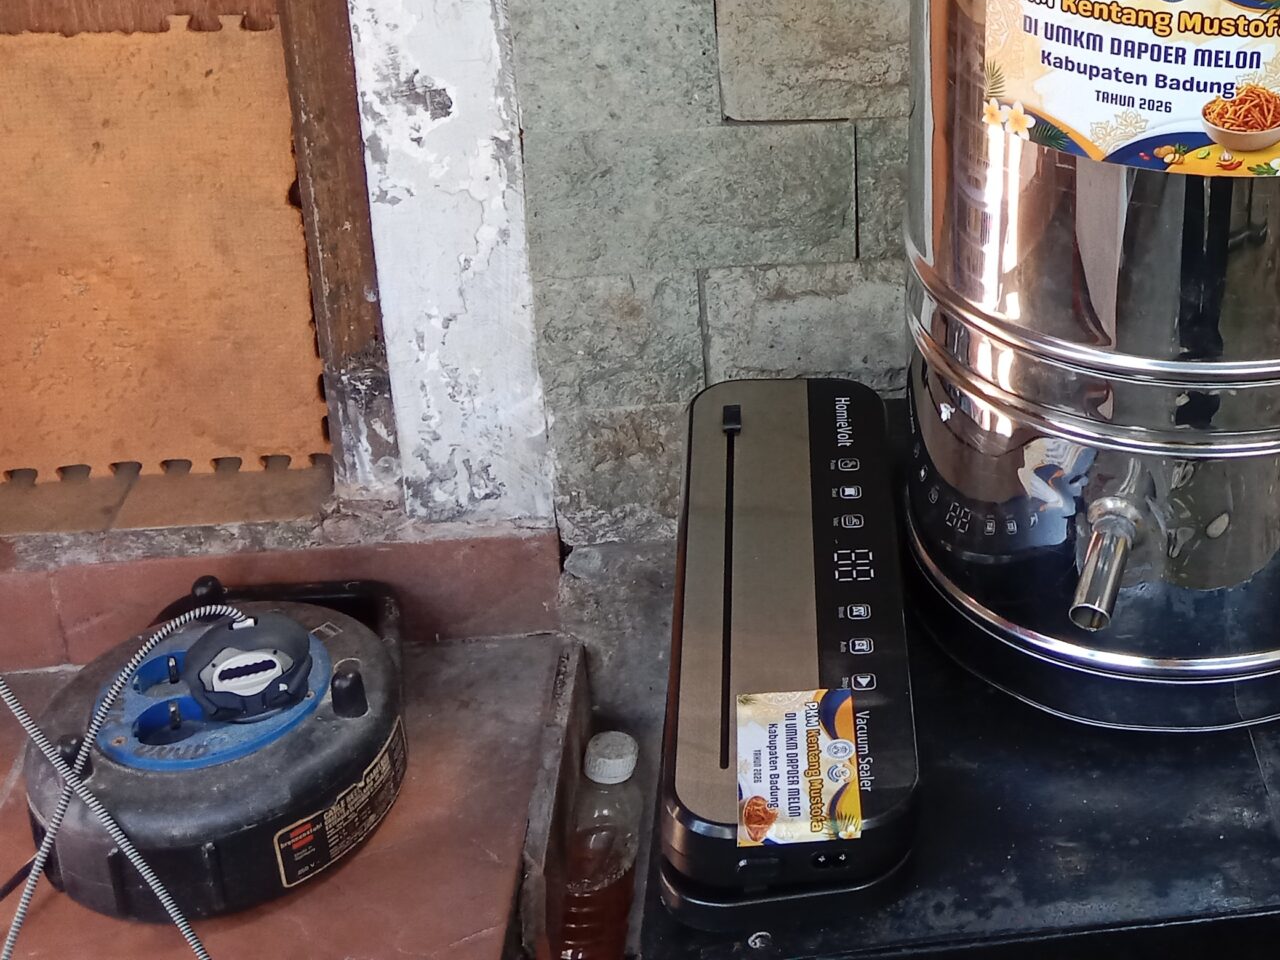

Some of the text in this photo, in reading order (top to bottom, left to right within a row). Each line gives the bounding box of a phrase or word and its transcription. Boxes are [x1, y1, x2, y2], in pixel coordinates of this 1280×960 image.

[1023, 14, 1262, 69] DI UMKM DAPOER MELON
[1041, 49, 1236, 99] Kabupaten Badung
[1095, 89, 1172, 114] TAHUN 2026
[835, 397, 854, 447] HomieVolt
[753, 749, 762, 767] TAHUN
[766, 723, 781, 809] Kabupaten Badung
[785, 712, 801, 818] DI UMKM DAPOER MELON
[804, 700, 826, 832] PKM Kentang Mustofa
[855, 710, 875, 792] Vacuum Sealer
